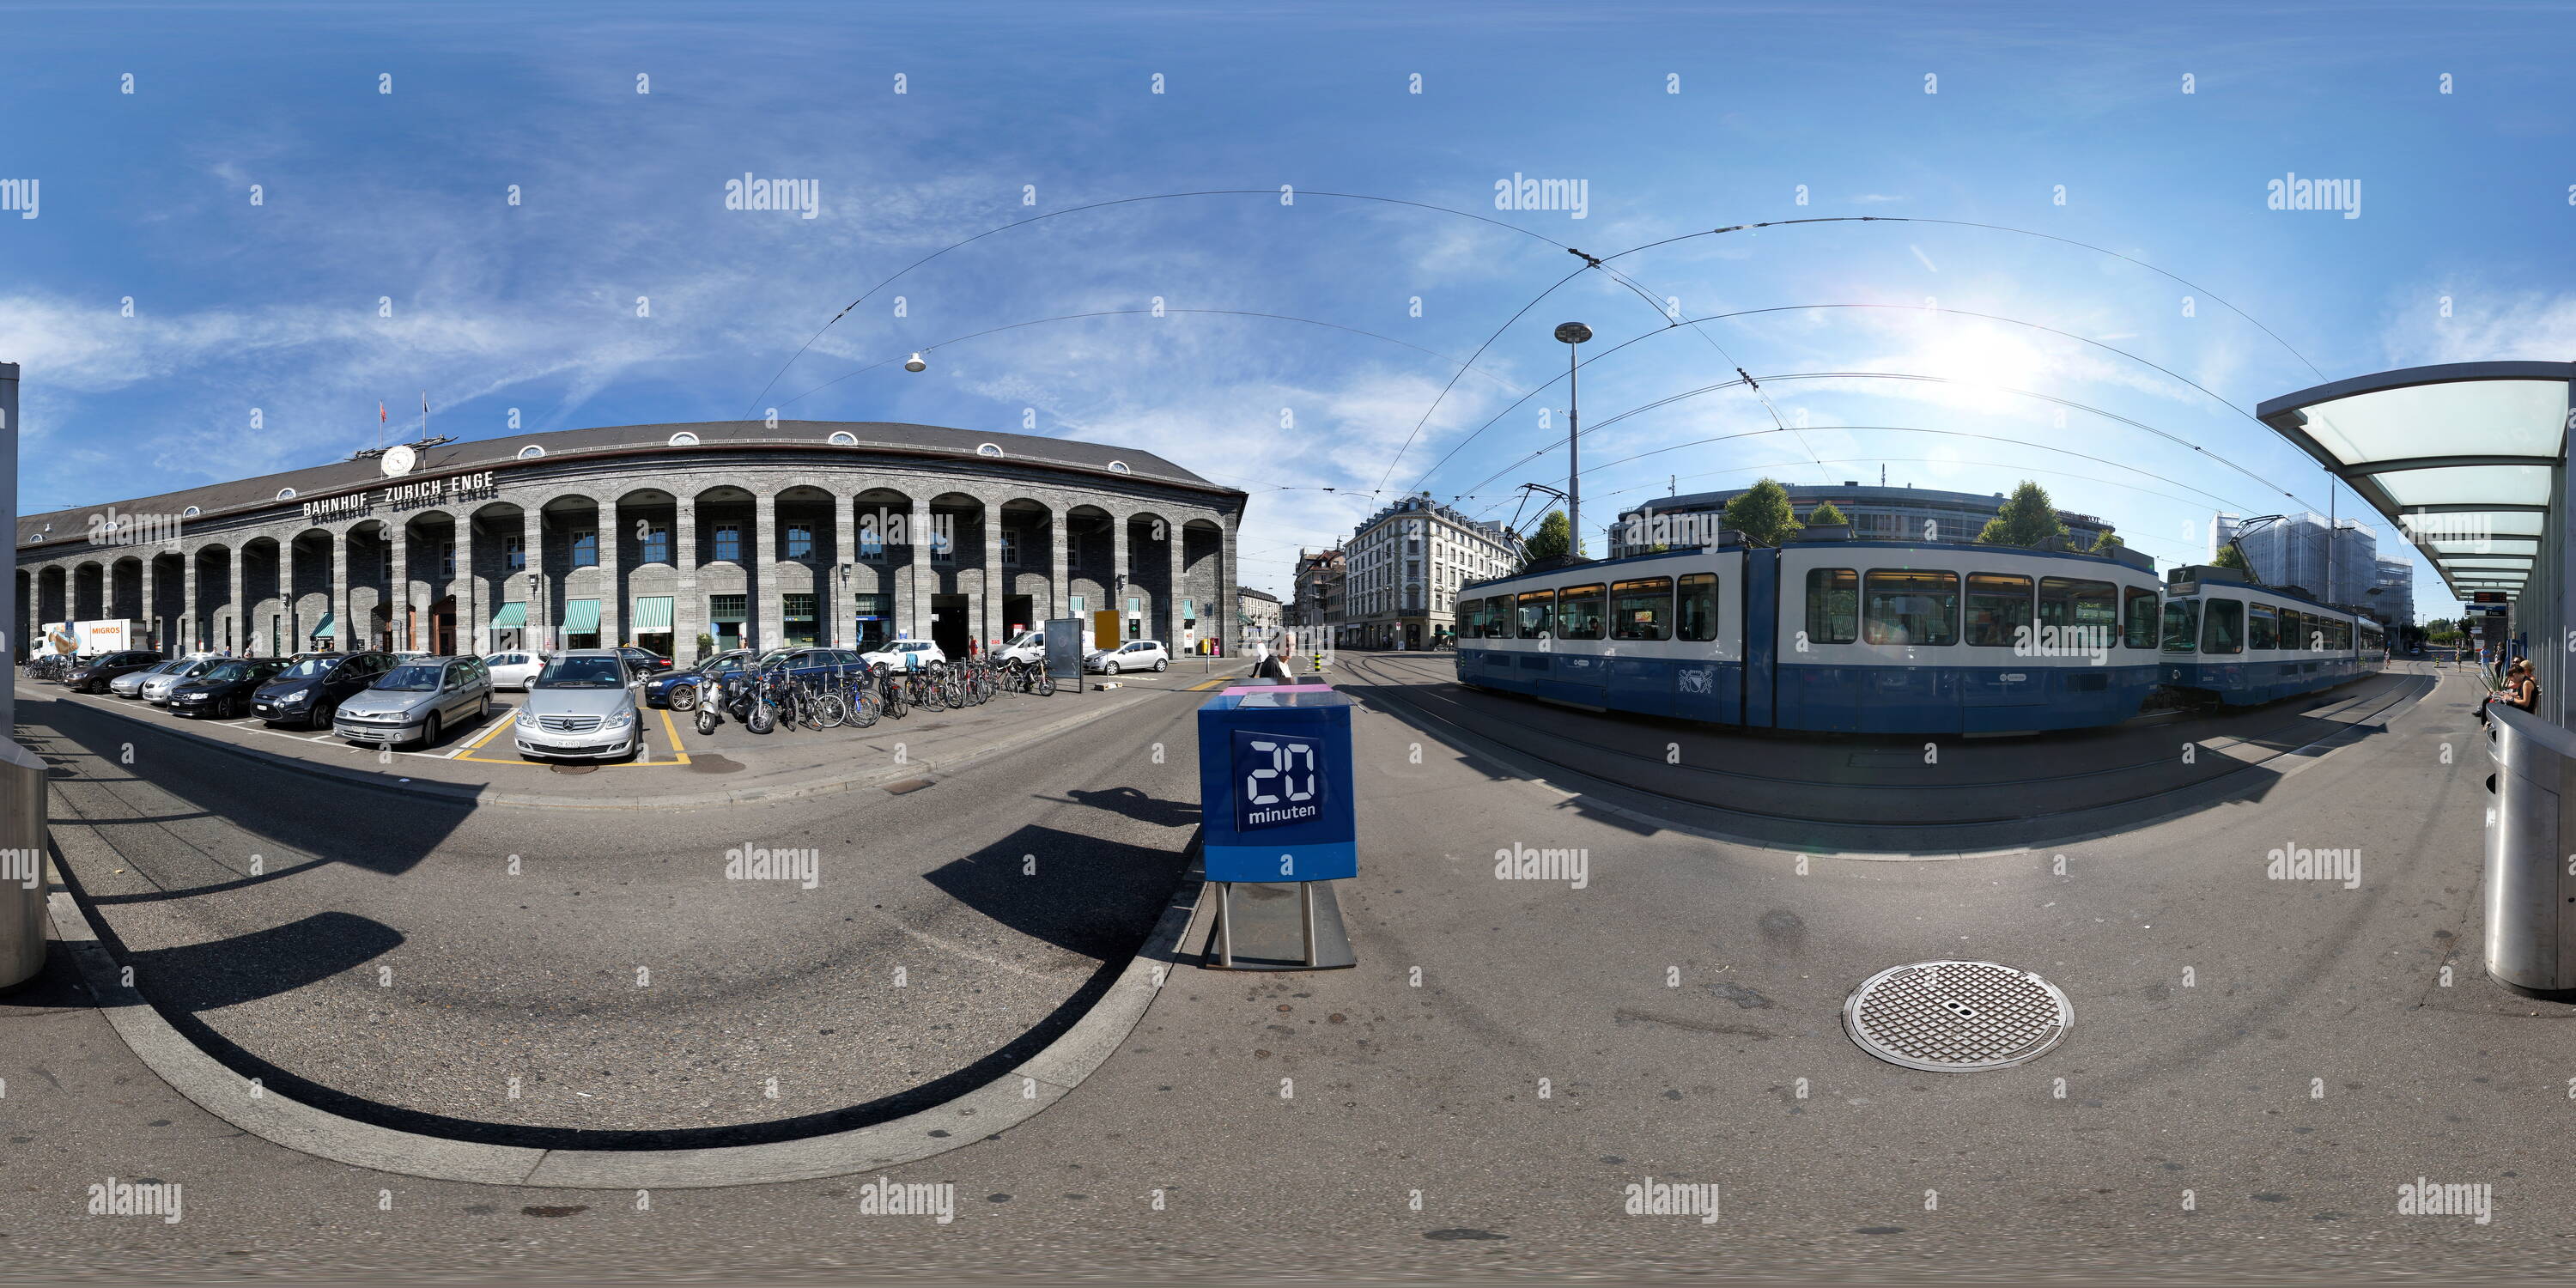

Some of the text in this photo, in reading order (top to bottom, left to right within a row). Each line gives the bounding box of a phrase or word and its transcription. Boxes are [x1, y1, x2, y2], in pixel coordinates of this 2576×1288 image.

[303, 471, 494, 516] BAHNHOF ZURICH ENGE
[2179, 570, 2186, 583] 7
[1248, 741, 1315, 805] 20
[1249, 805, 1315, 824] minuten
